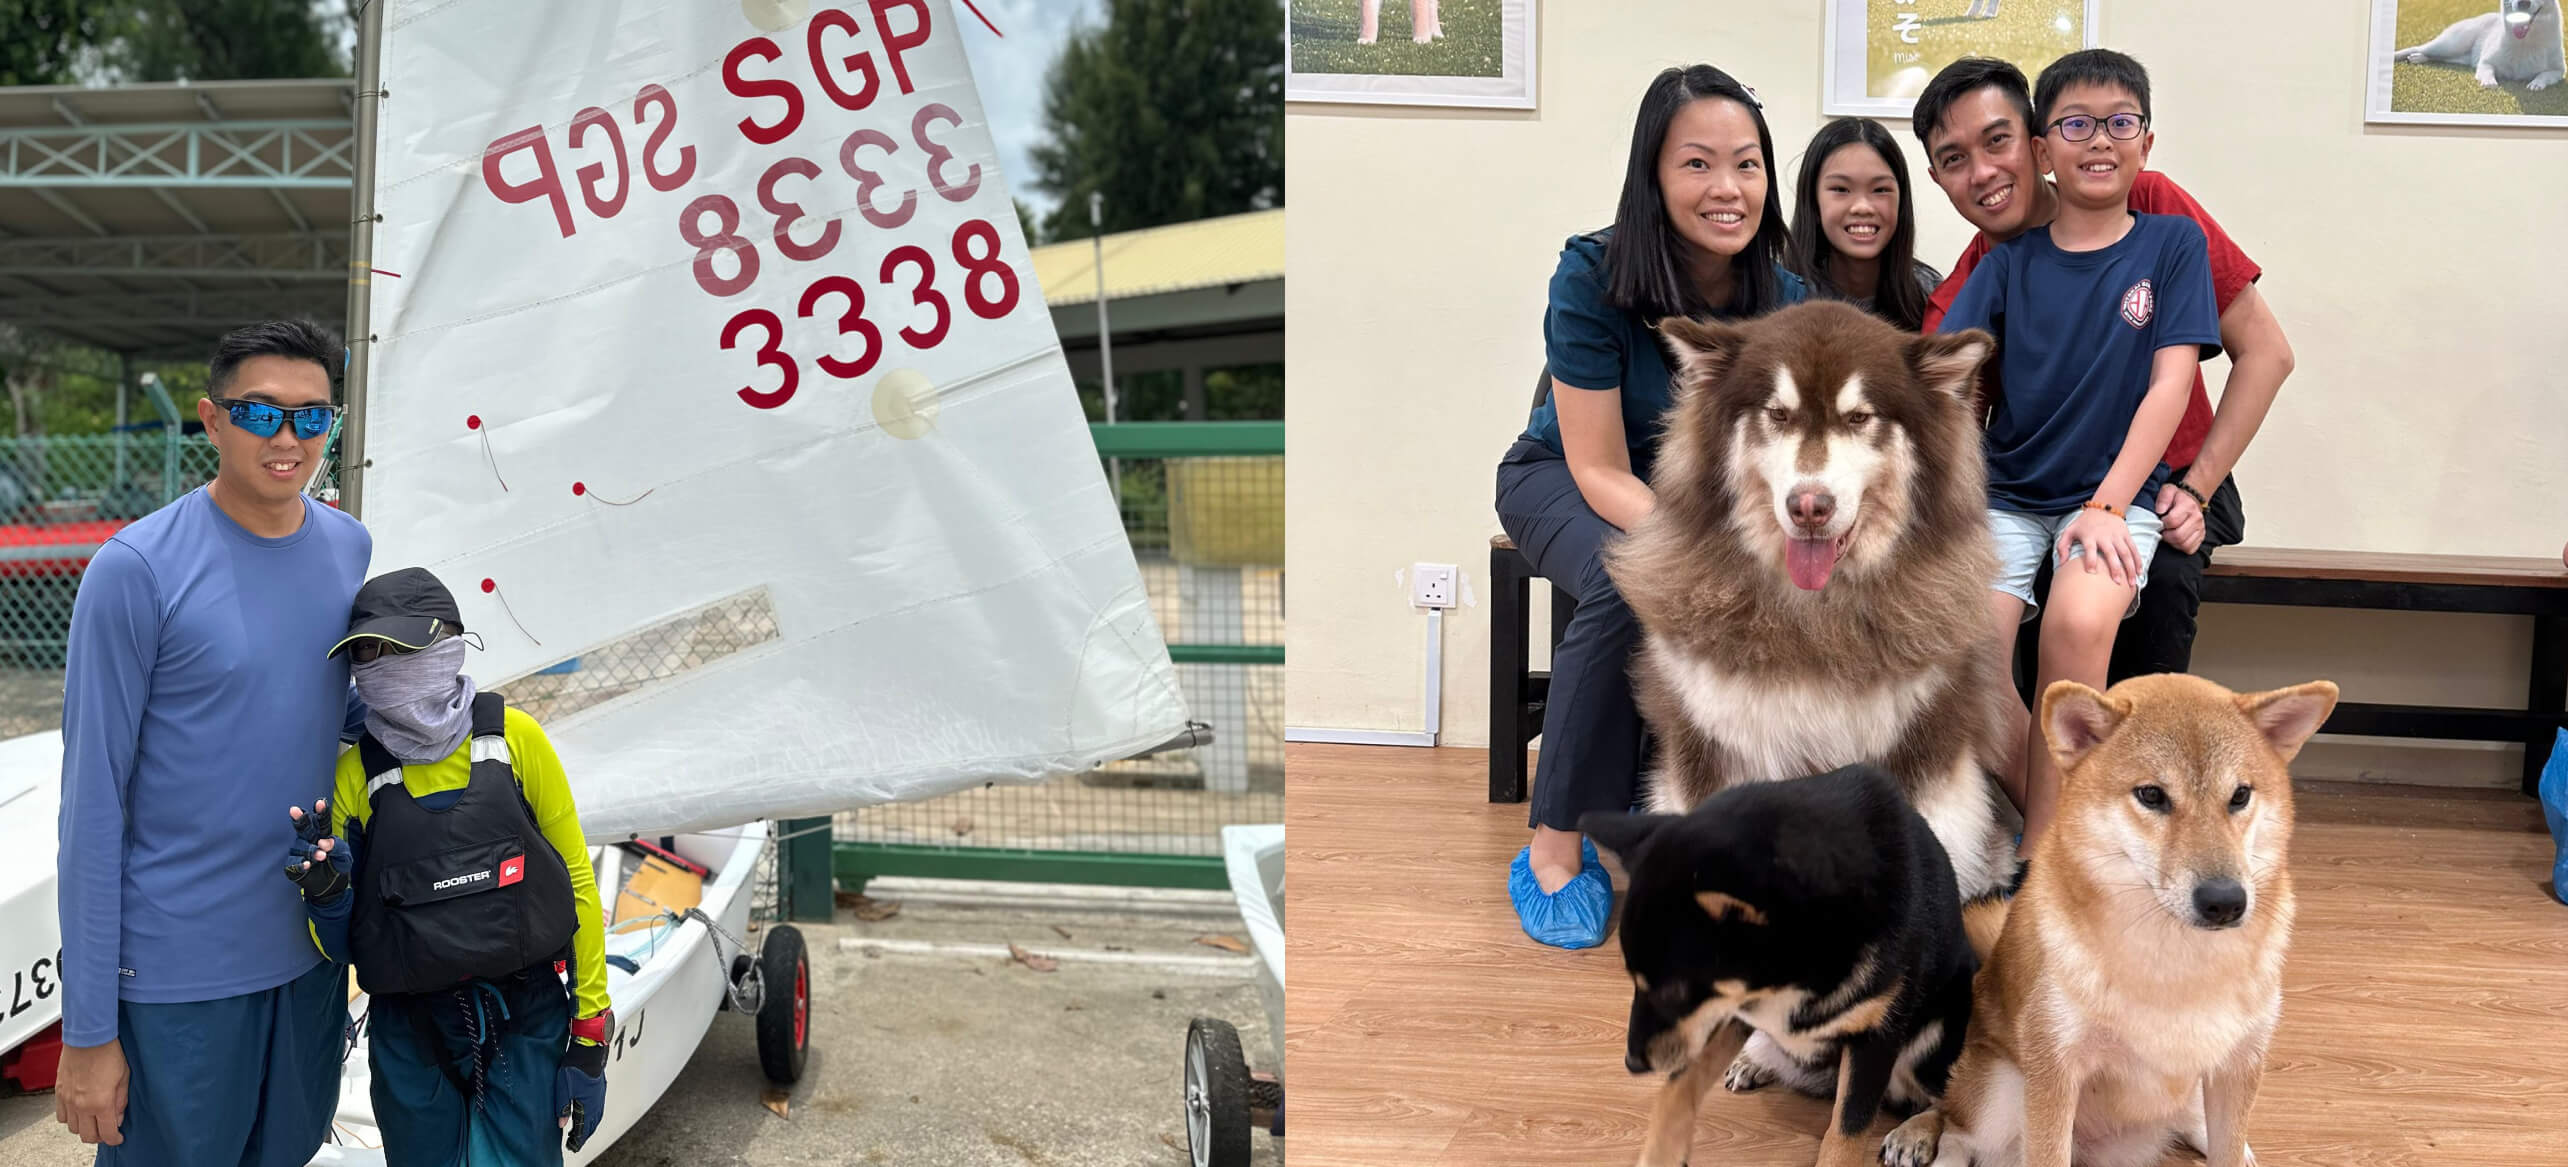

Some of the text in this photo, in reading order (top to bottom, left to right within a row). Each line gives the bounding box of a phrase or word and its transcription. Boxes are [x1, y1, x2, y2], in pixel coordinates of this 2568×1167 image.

[1892, 0, 1922, 44] そ
[722, 0, 931, 145] SGP
[720, 219, 1020, 409] 3338
[433, 870, 491, 891] ROOSTER
